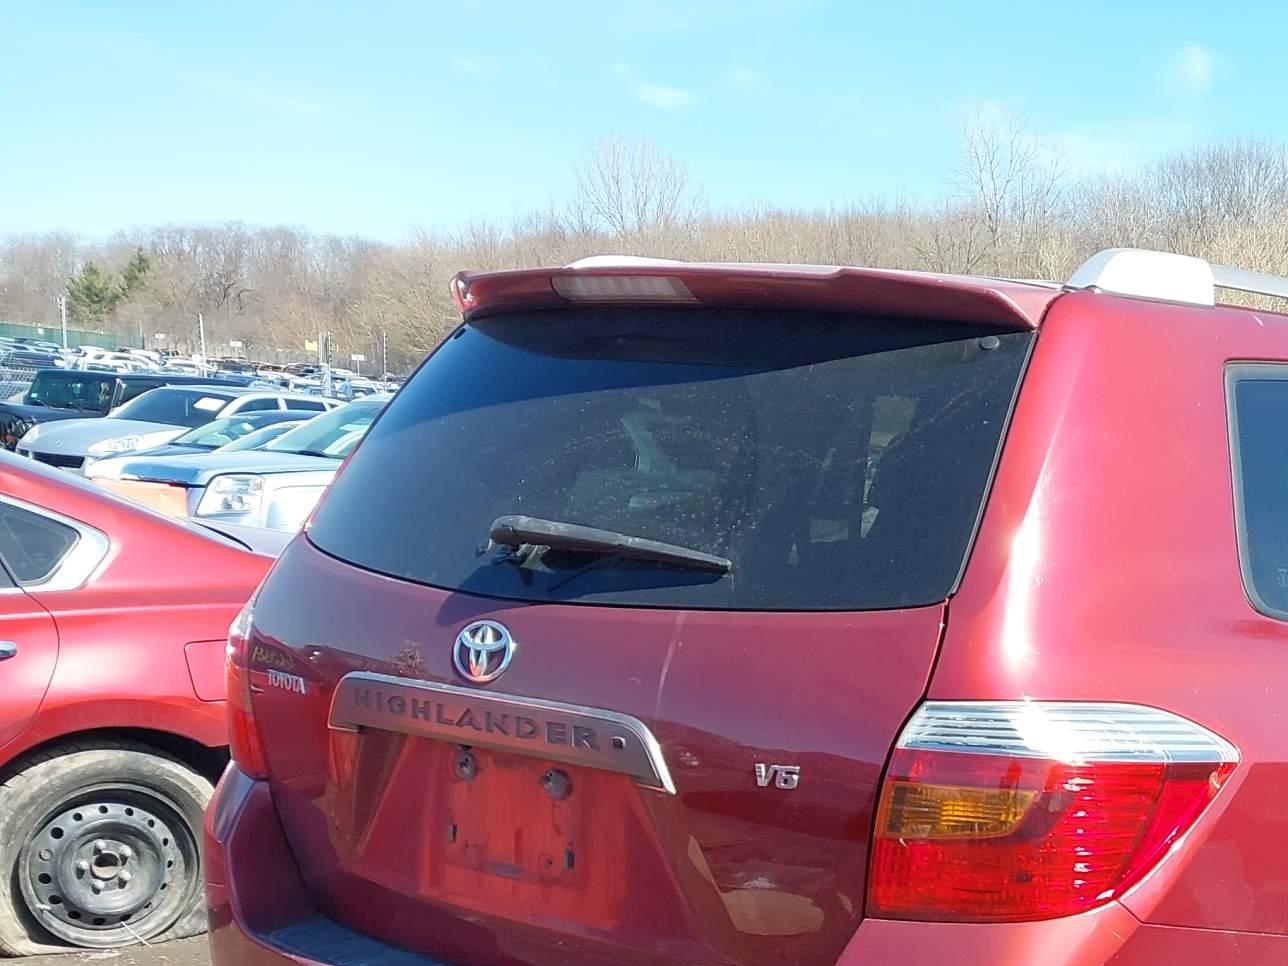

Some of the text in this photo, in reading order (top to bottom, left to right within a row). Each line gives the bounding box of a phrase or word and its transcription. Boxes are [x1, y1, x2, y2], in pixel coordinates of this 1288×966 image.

[267, 668, 306, 695] TOYOTA
[353, 687, 600, 751] HIGHLANDER
[755, 763, 801, 789] V6
